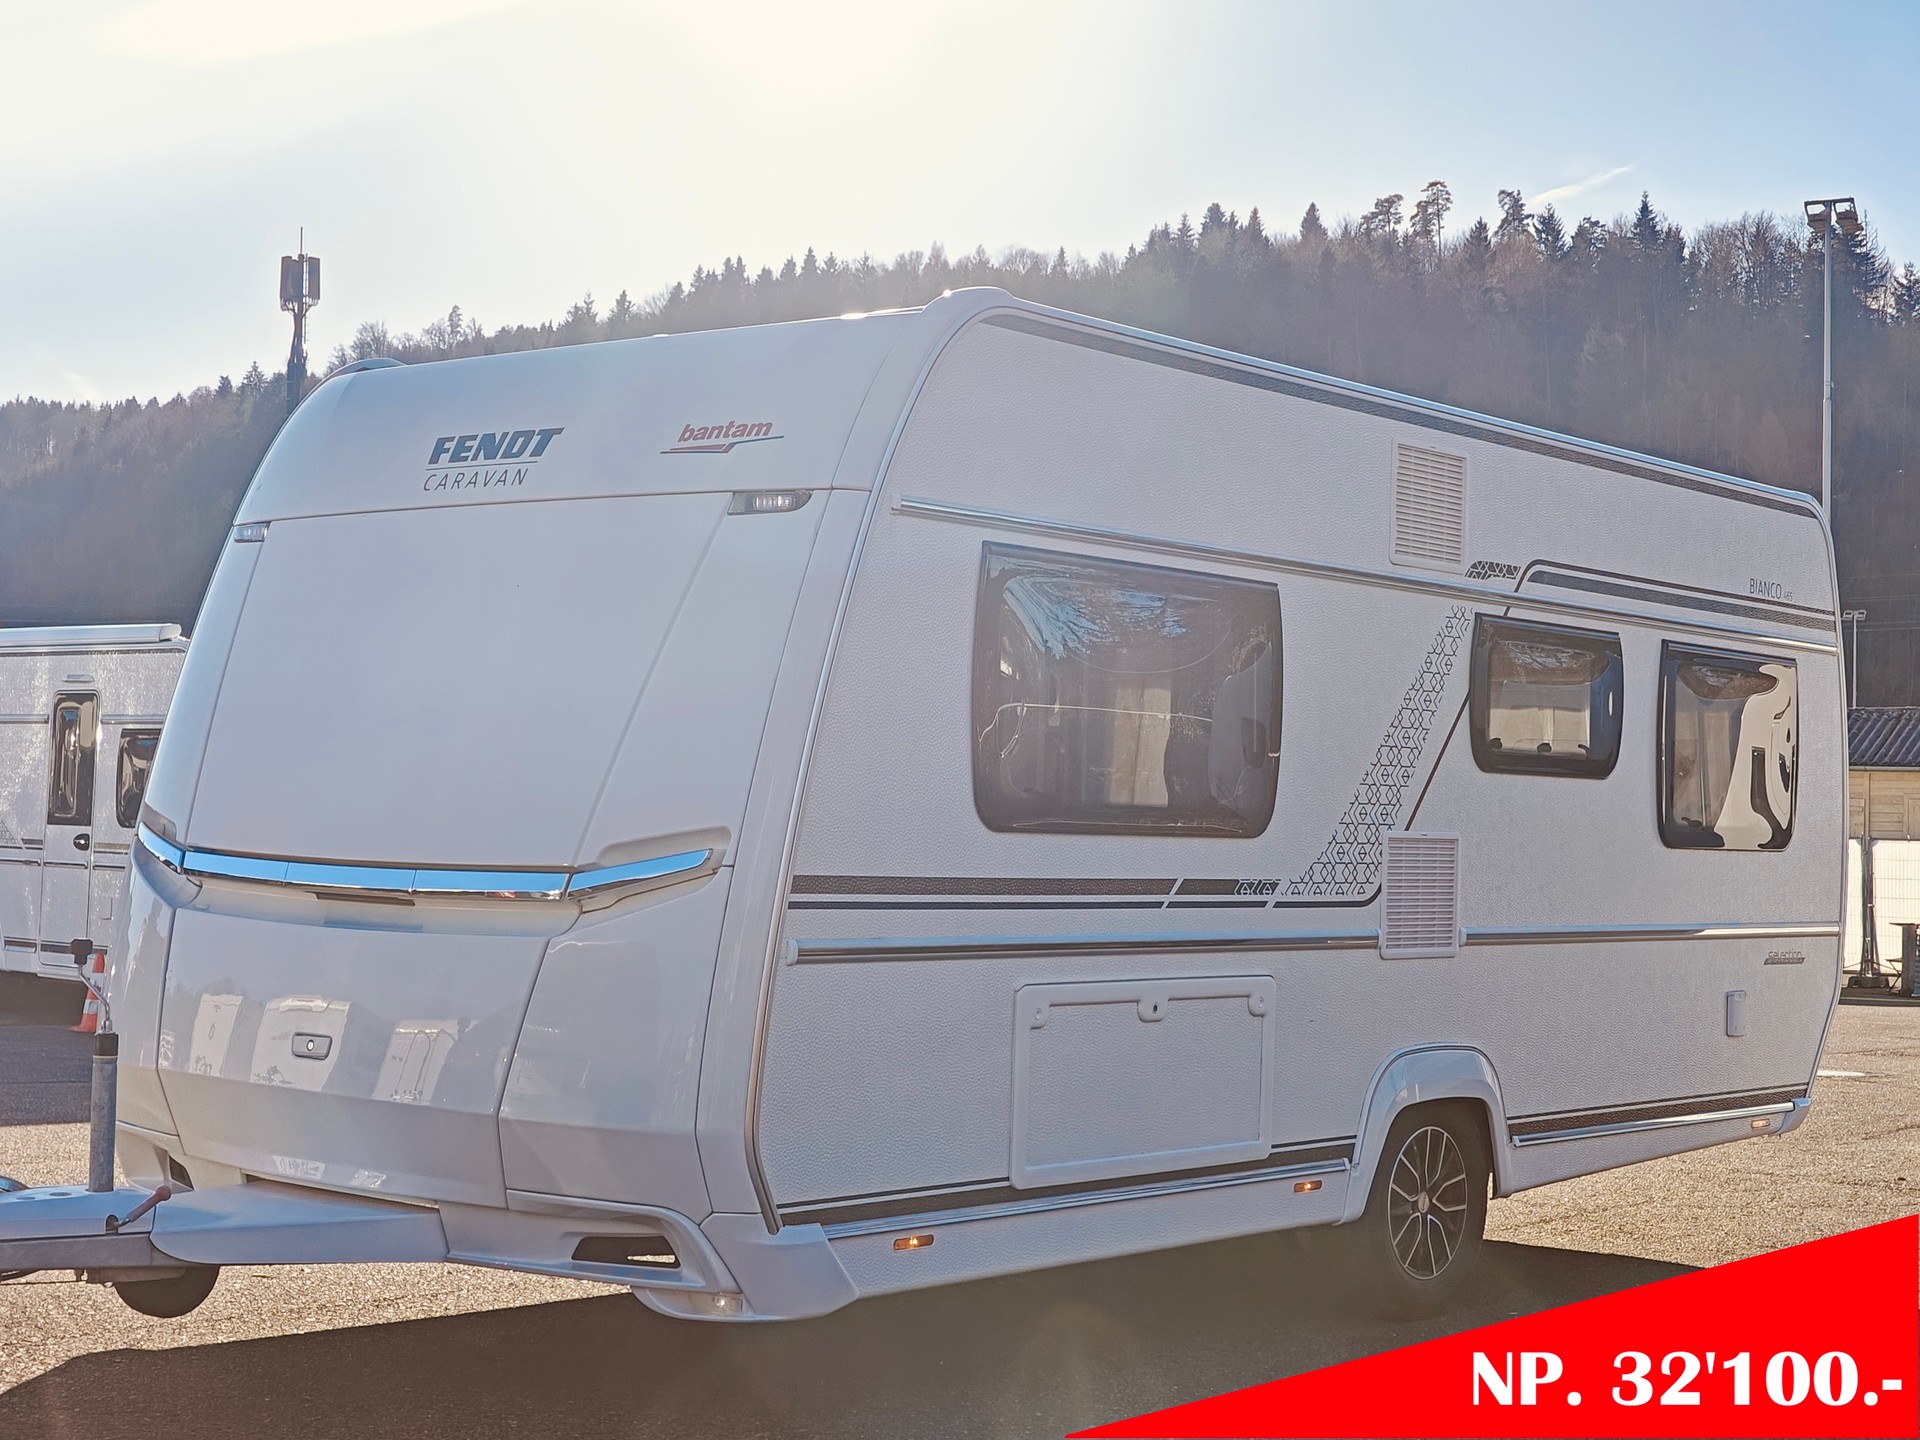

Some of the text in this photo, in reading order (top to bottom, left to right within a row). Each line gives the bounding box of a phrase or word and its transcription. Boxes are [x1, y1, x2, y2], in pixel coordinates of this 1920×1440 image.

[677, 420, 774, 443] bantam
[427, 426, 565, 466] FENDT
[422, 467, 529, 492] CARAVAN
[1749, 578, 1782, 599] BIANCO
